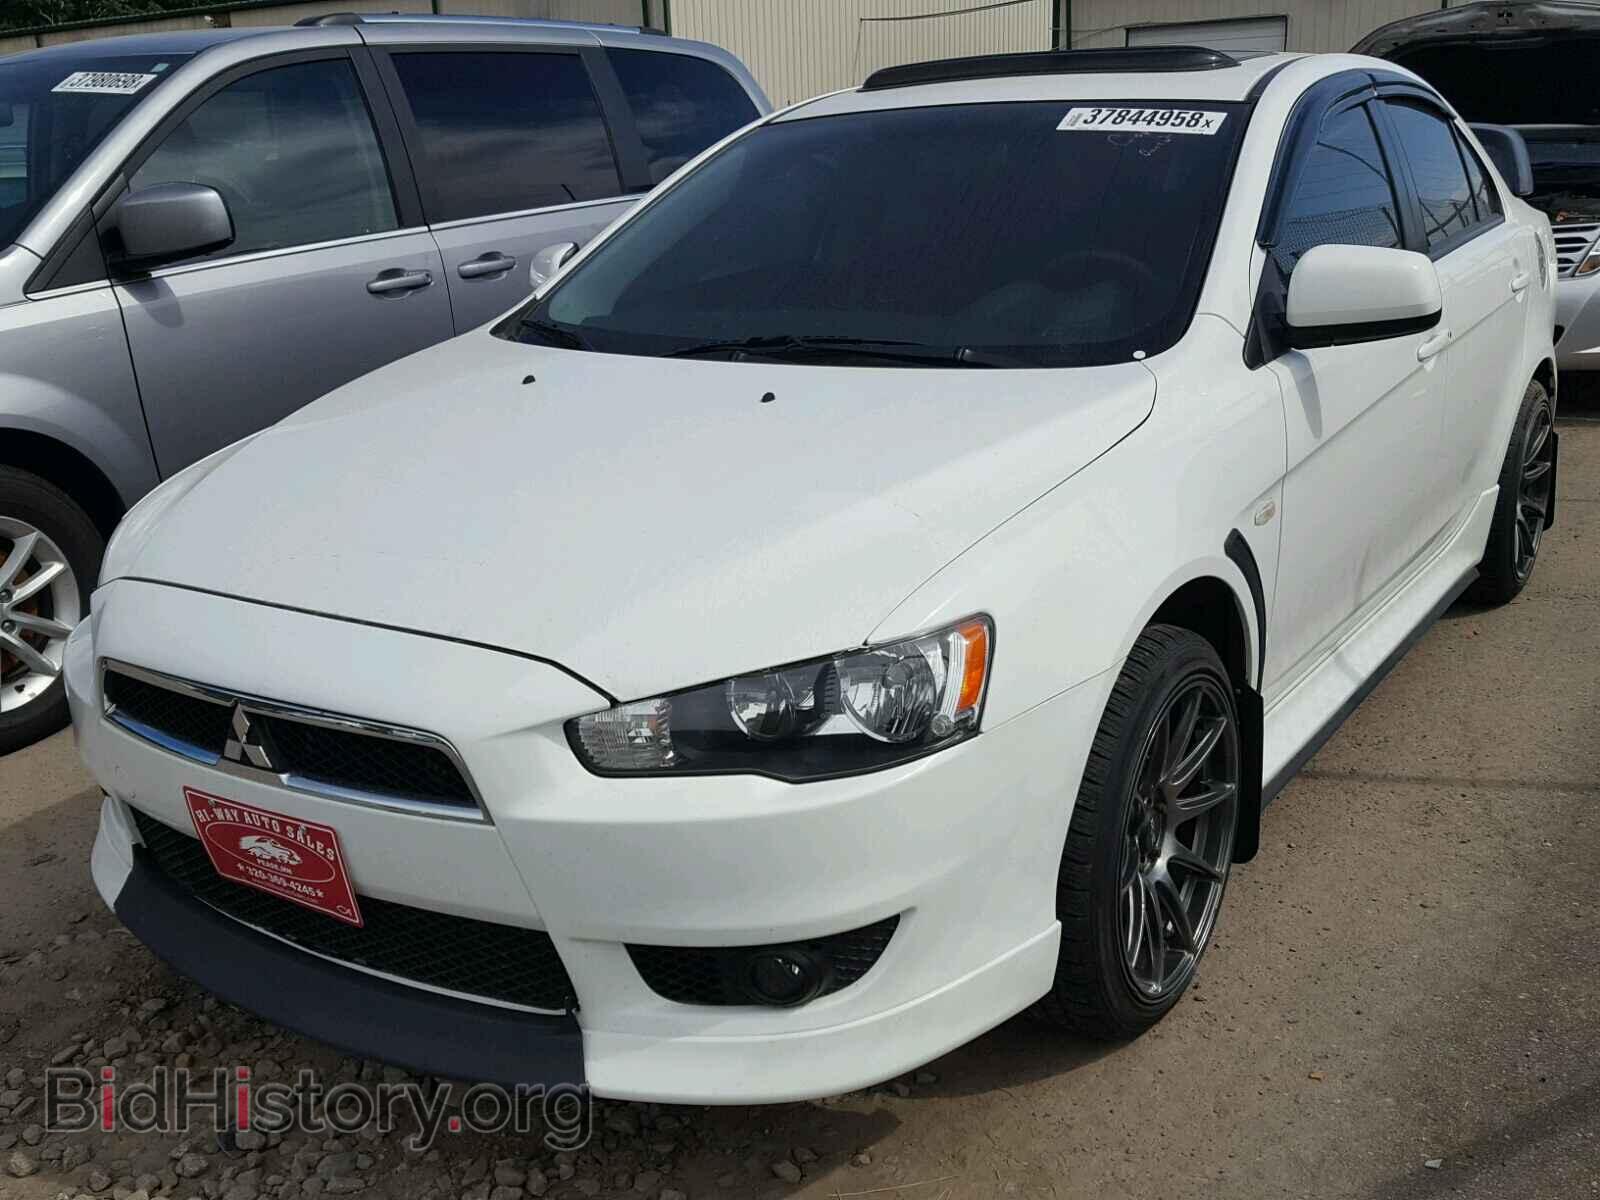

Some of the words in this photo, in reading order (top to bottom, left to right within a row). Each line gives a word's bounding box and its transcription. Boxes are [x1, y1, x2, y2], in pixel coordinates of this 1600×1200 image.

[194, 807, 241, 823] HI-WAY
[244, 811, 280, 833] AUTO
[286, 825, 335, 861] SALES
